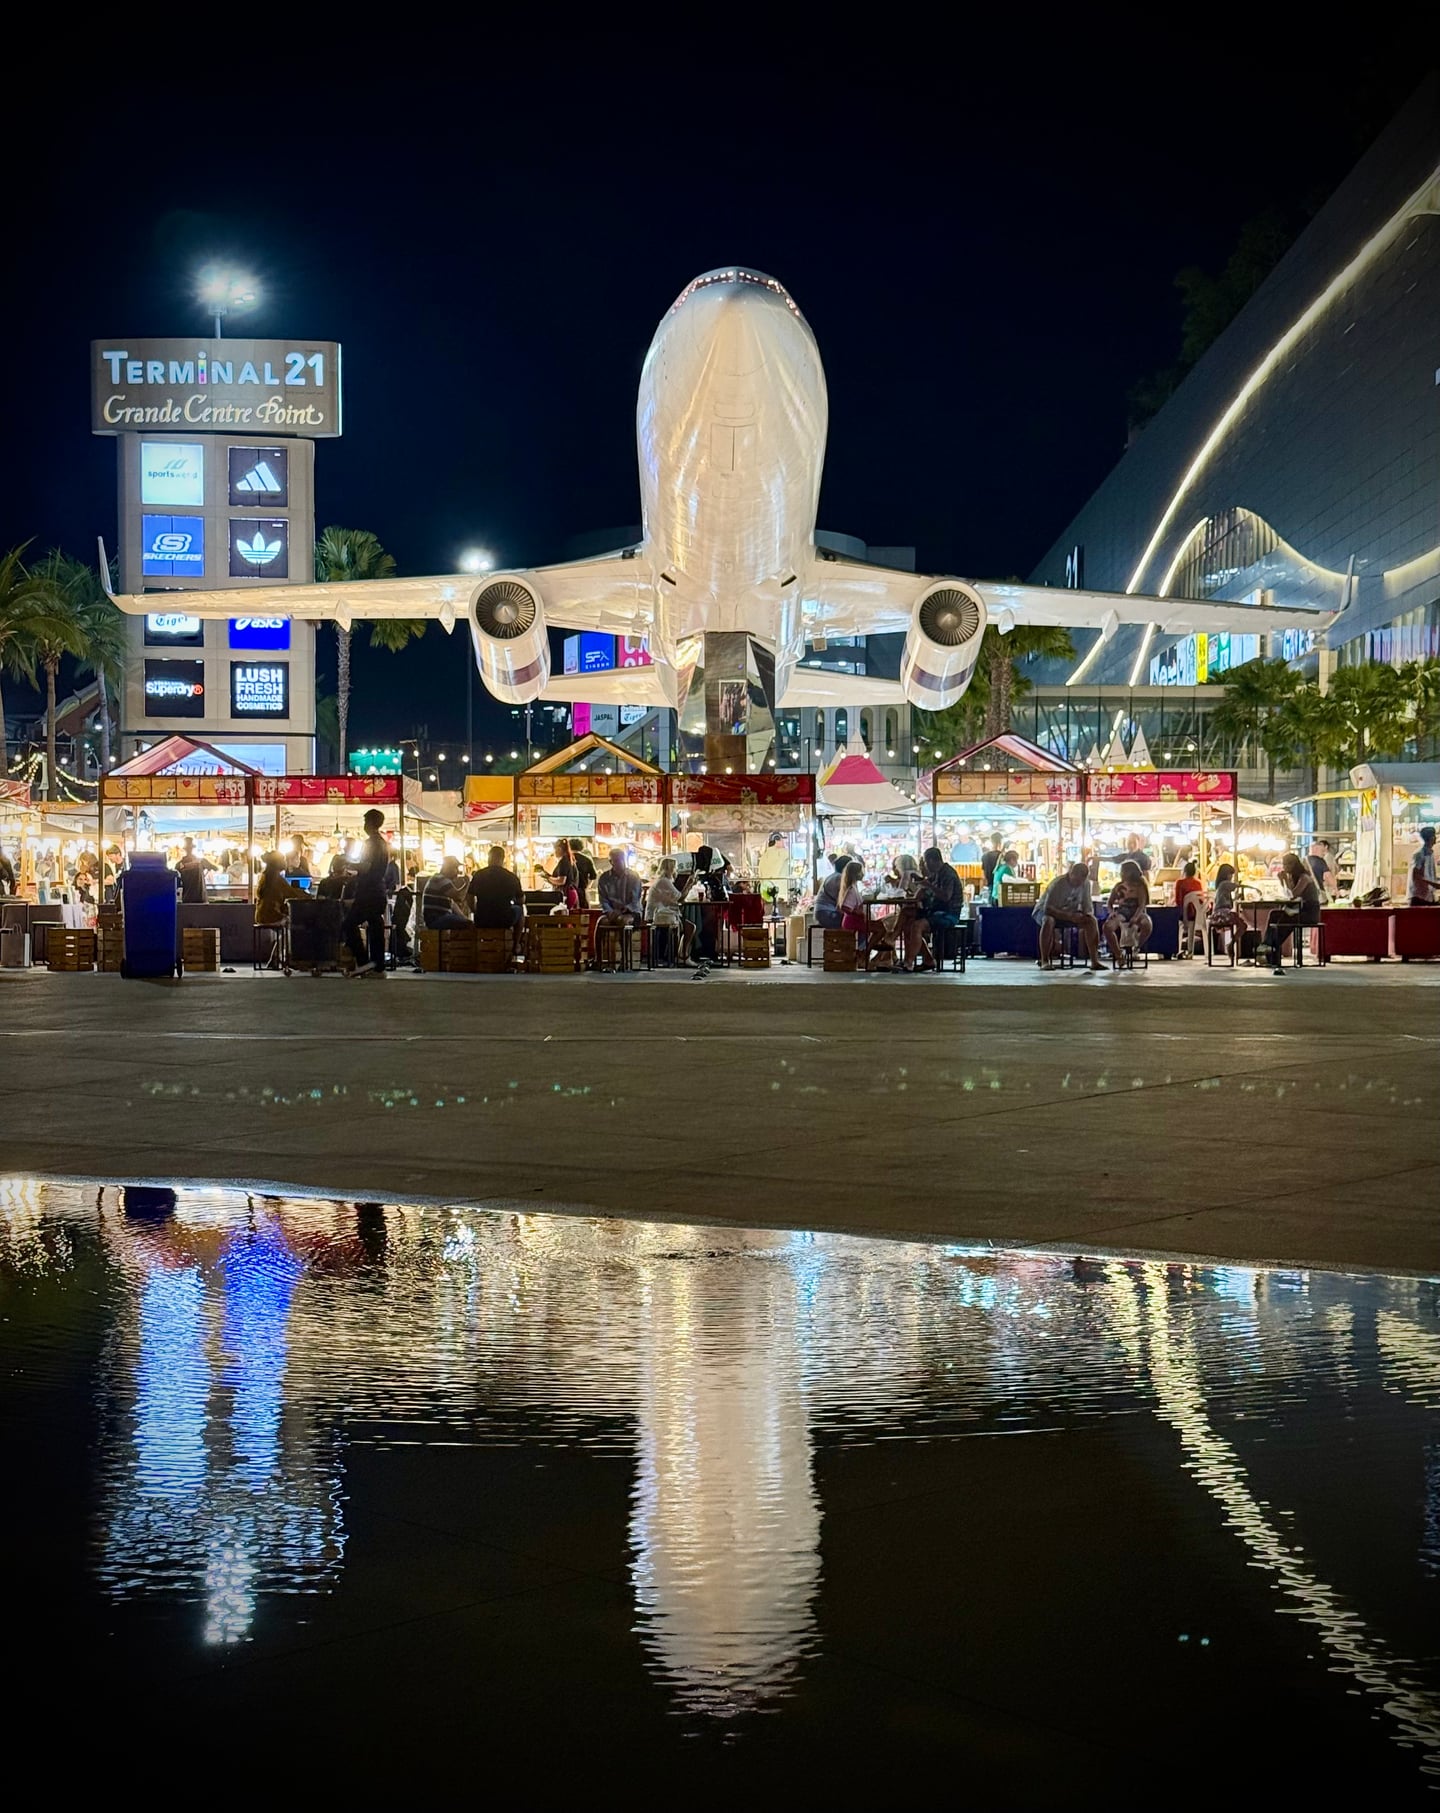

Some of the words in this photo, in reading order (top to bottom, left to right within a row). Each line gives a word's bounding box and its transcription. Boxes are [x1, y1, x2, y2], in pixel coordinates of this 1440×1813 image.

[103, 395, 181, 424] Grande
[184, 394, 252, 424] Centre
[256, 396, 324, 425] Point
[143, 553, 202, 561] SKECHERS
[236, 668, 283, 682] LUSH
[236, 683, 283, 695] FRESH
[236, 695, 283, 703] HANDMADE
[236, 702, 284, 711] COSMETICS
